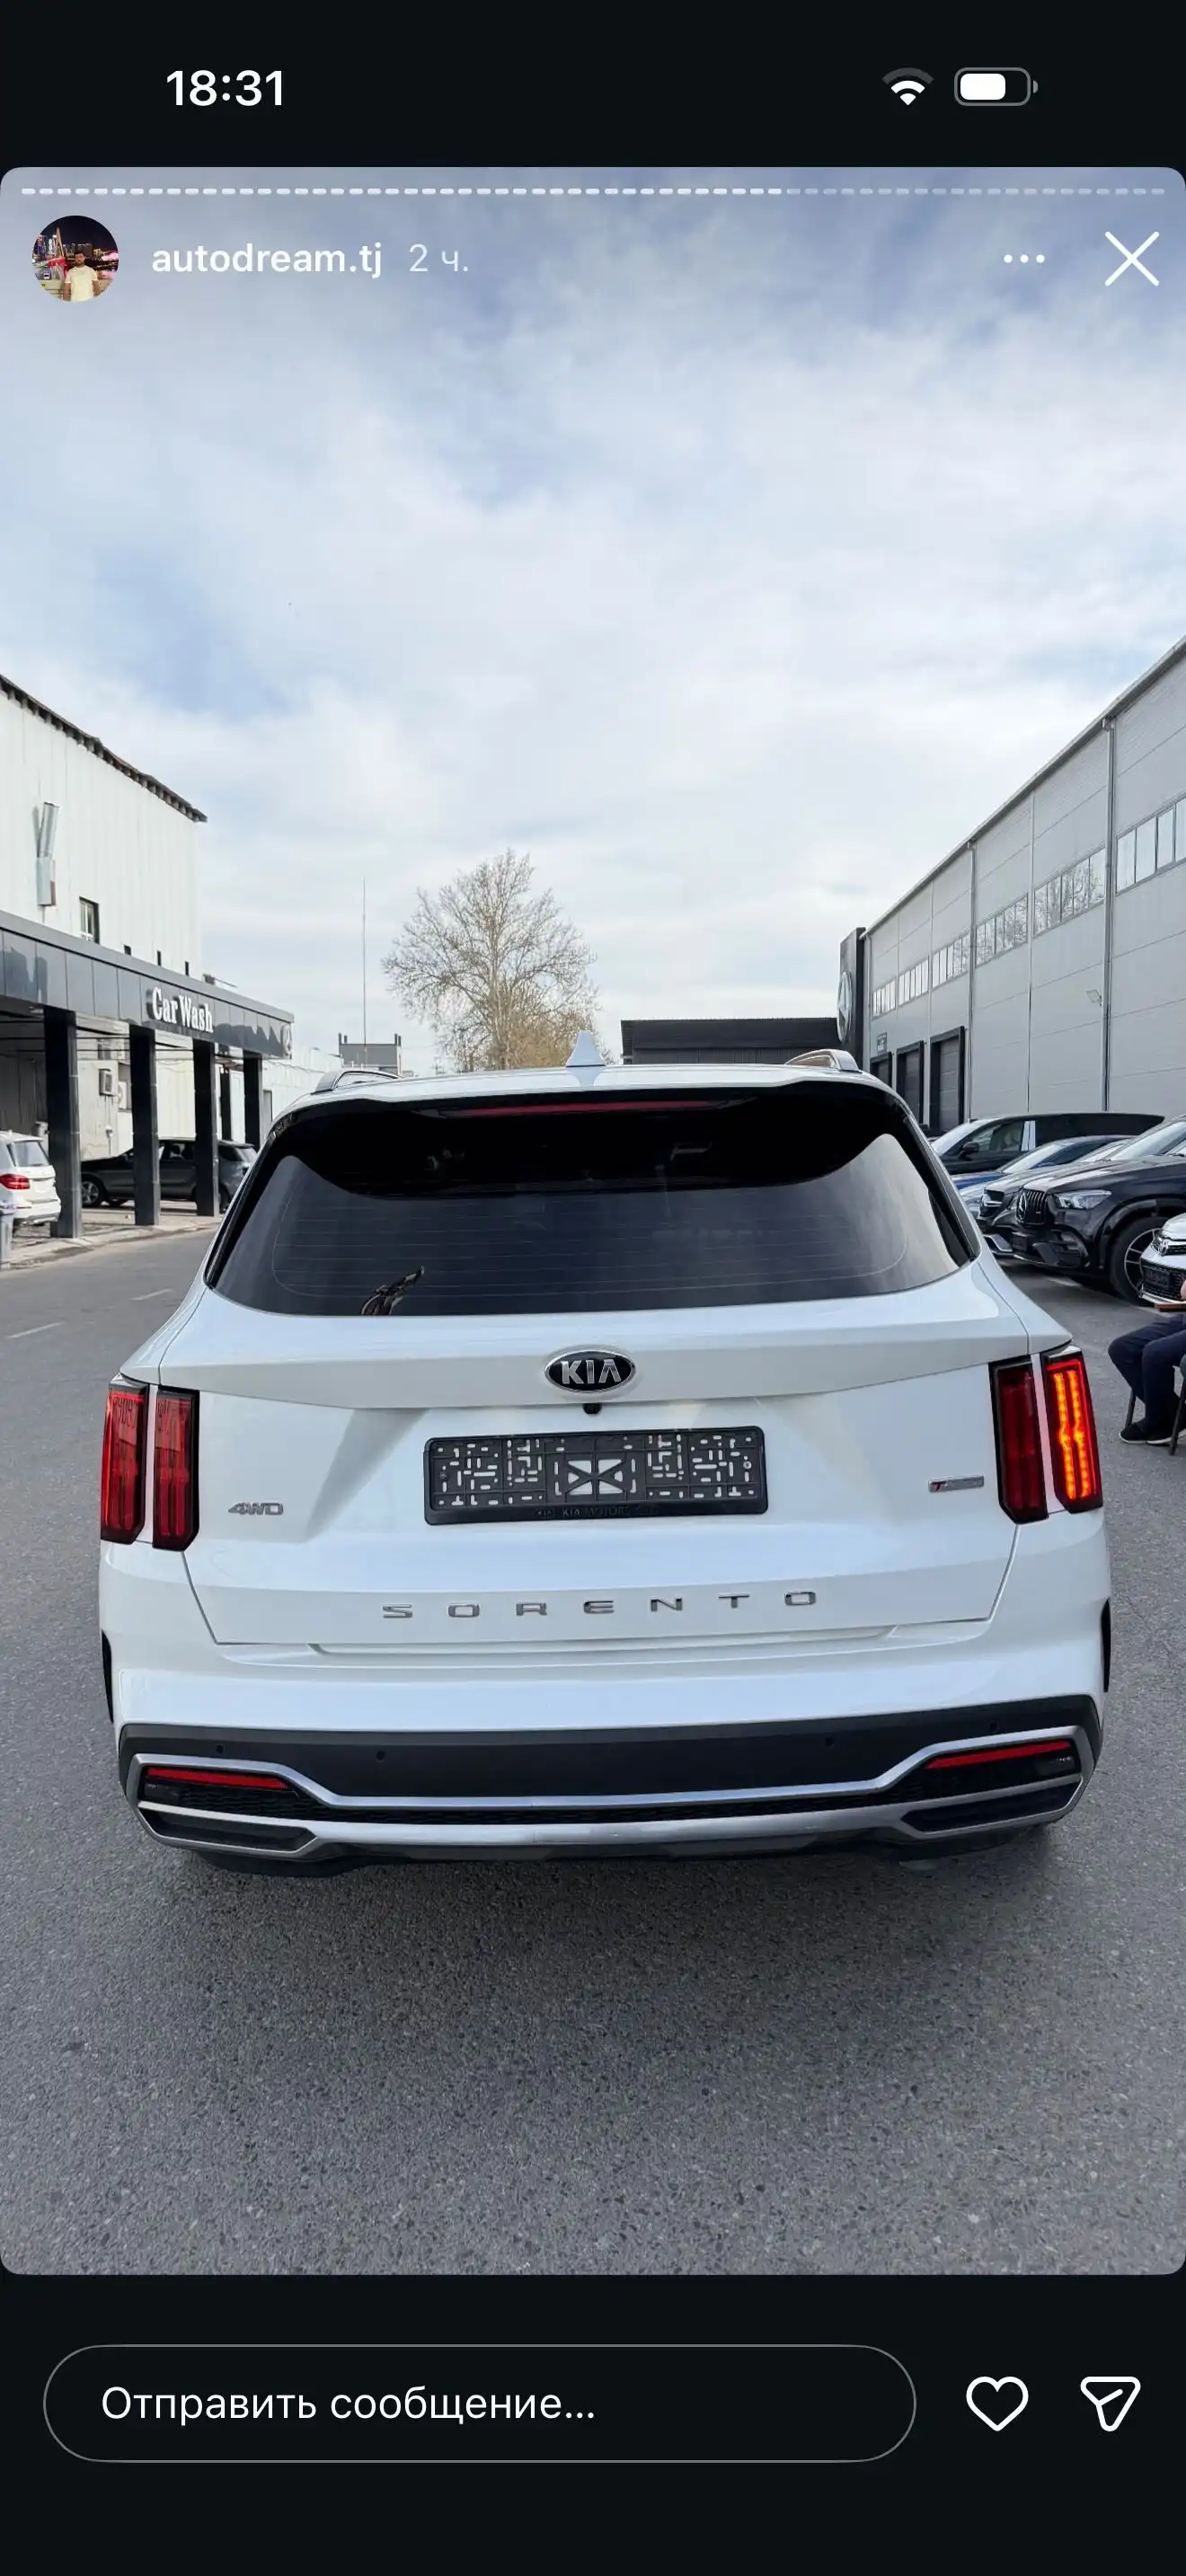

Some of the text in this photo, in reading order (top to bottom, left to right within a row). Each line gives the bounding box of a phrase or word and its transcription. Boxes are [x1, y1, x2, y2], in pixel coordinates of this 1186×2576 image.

[152, 986, 214, 1034] Car Wash
[561, 1358, 622, 1385] KIA
[227, 1502, 284, 1515] 4WD
[562, 1508, 580, 1517] KIA
[383, 1590, 817, 1619] SORENTO
